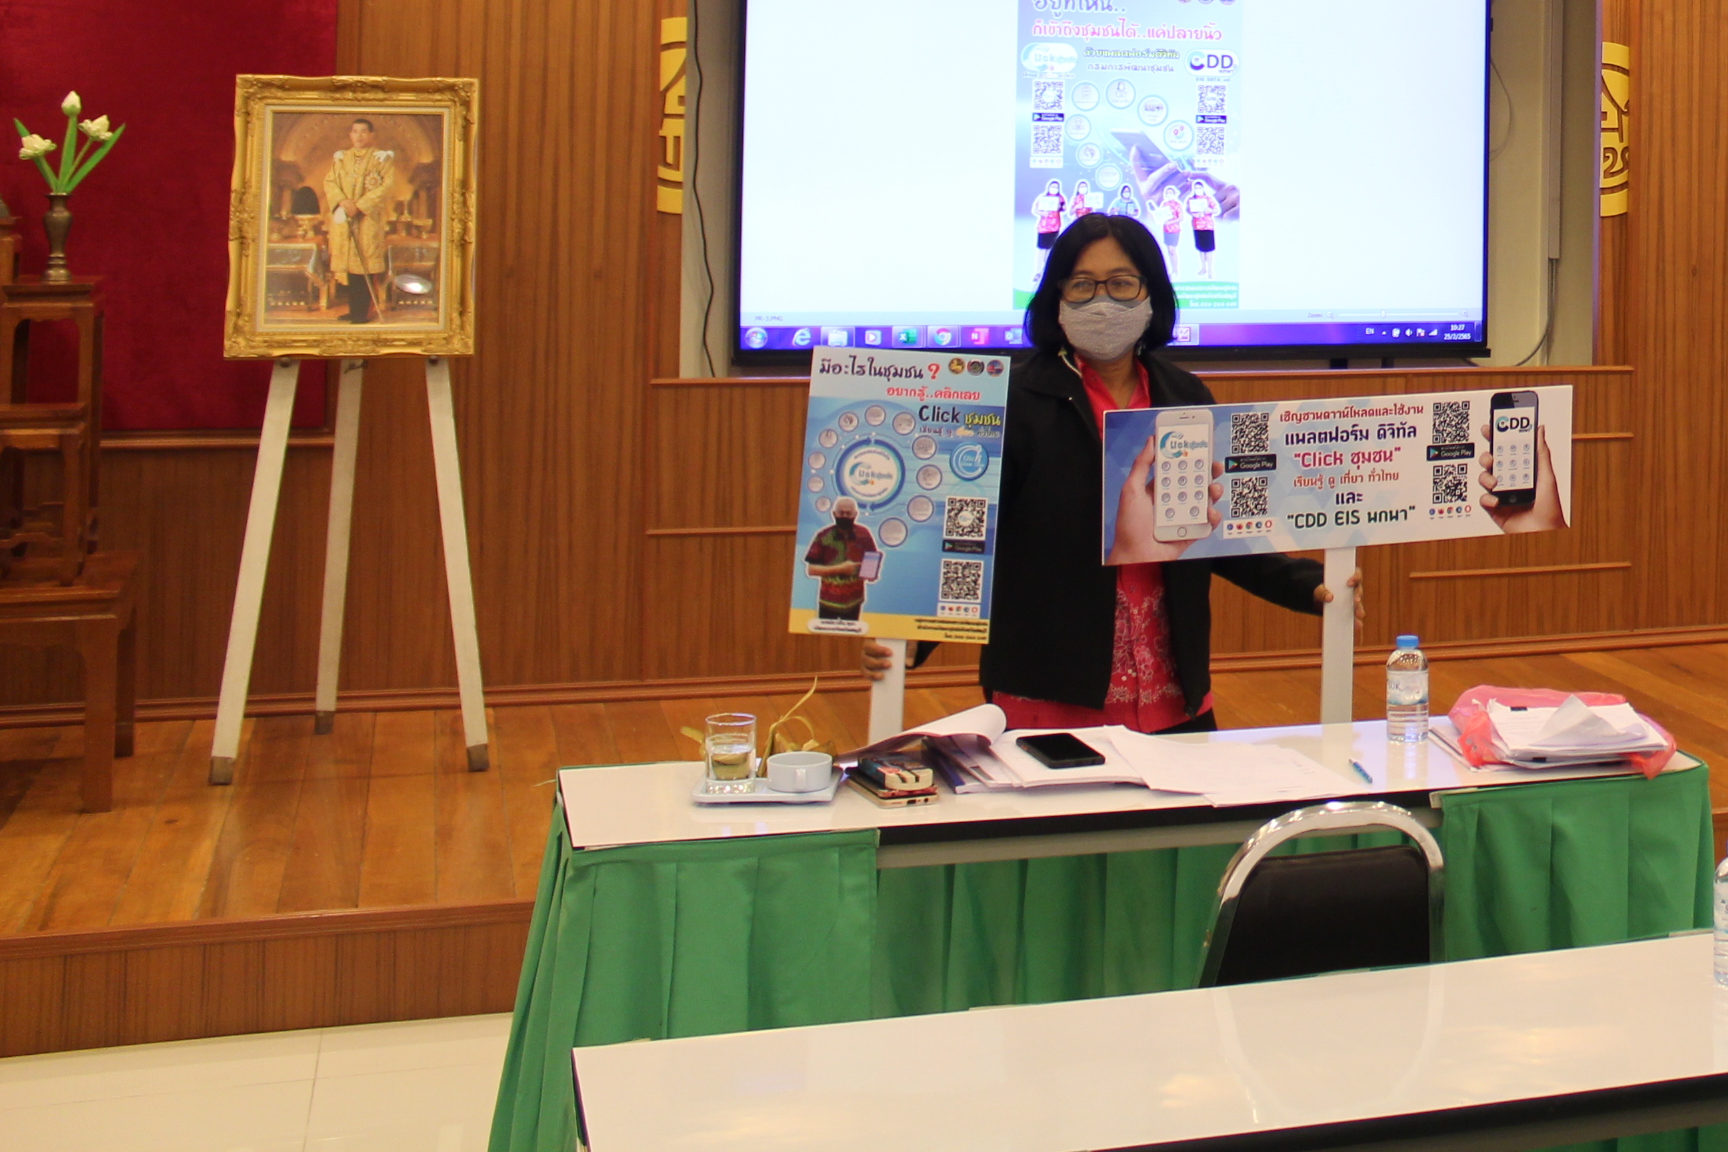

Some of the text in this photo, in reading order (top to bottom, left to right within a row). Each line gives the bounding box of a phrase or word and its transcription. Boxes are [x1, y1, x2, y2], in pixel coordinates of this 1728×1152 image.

[819, 355, 941, 382] มีอะไรในชุมชน ?
[886, 386, 981, 401] อยากรู้..คลิกเลย
[918, 405, 1001, 429] Click ชุมชน
[1280, 403, 1424, 425] เชิญชวนดาวน์โหลดและใช้งาน
[1285, 421, 1417, 446] แพลตฟอร์ม ดิจิทัล
[1294, 446, 1401, 470] "Click ชุมชน"
[1293, 469, 1400, 490] เรียนรู้ ดู เที่ยว ทั่วไทย
[1335, 491, 1363, 505] และ
[1287, 505, 1416, 529] "CDD EIS พกพา"
